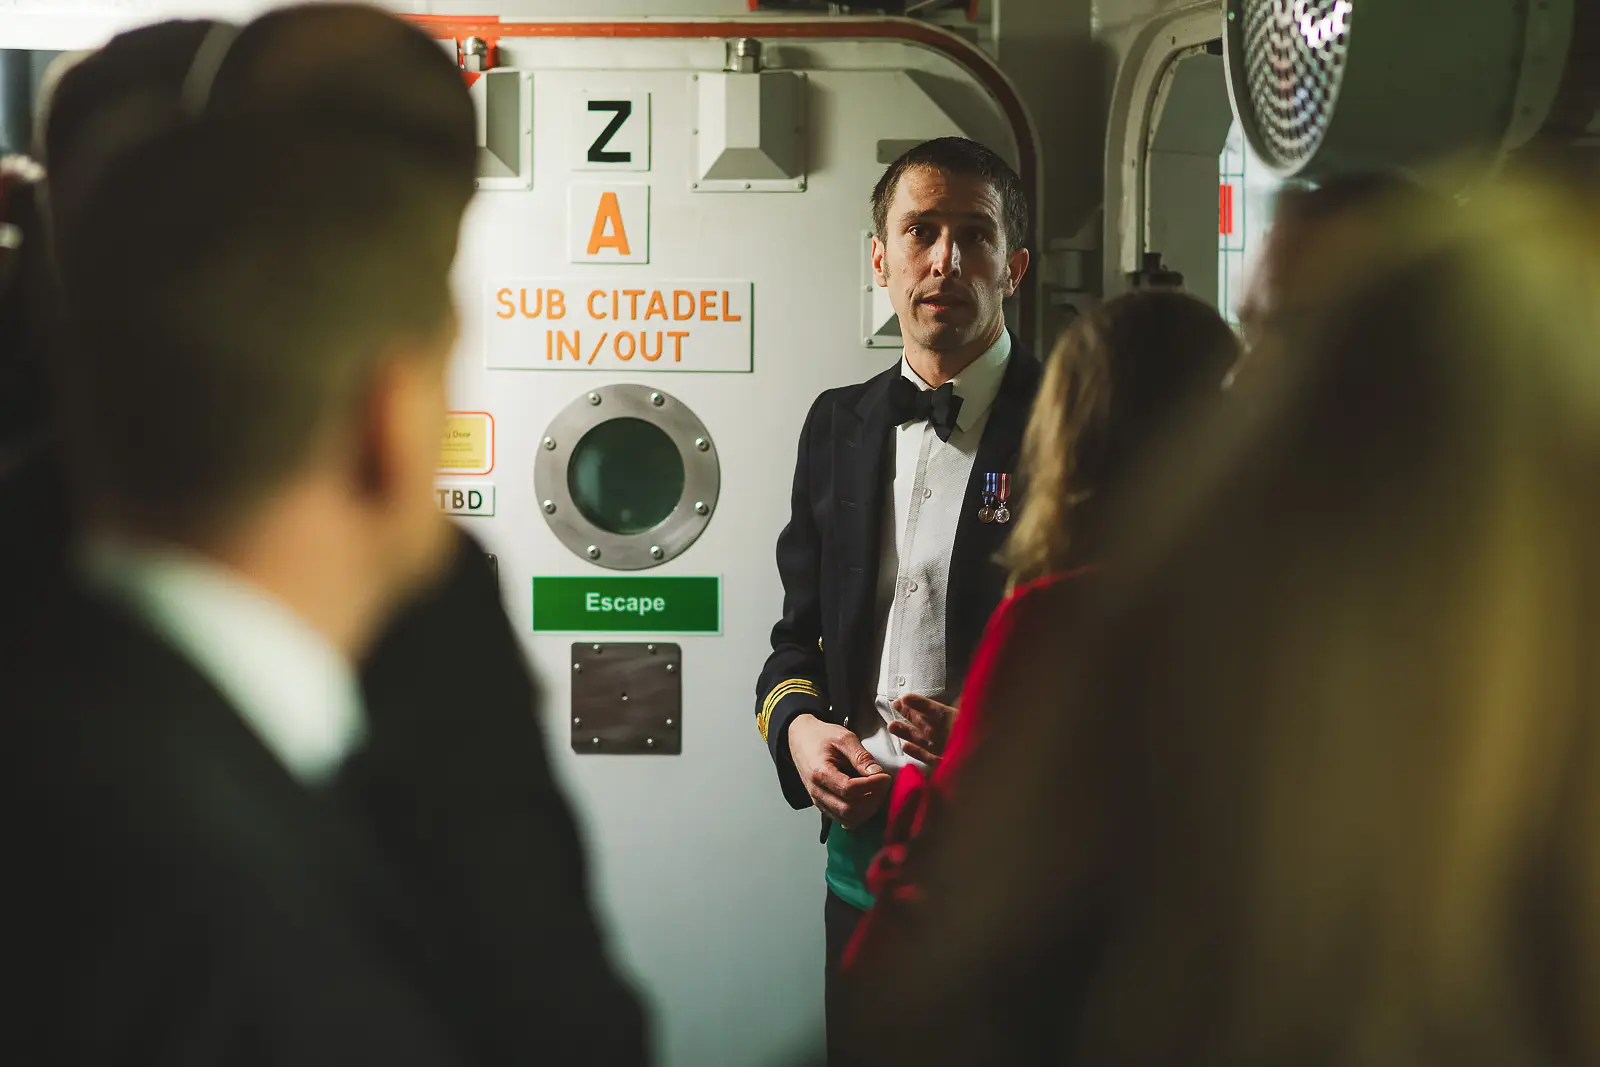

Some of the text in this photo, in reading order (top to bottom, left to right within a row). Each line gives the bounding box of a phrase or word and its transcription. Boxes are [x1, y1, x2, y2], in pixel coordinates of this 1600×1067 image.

[587, 100, 632, 163] Z
[586, 191, 631, 255] A
[496, 287, 742, 322] SUB CITADEL
[546, 330, 690, 365] IN/OUT
[585, 592, 665, 616] Escape
